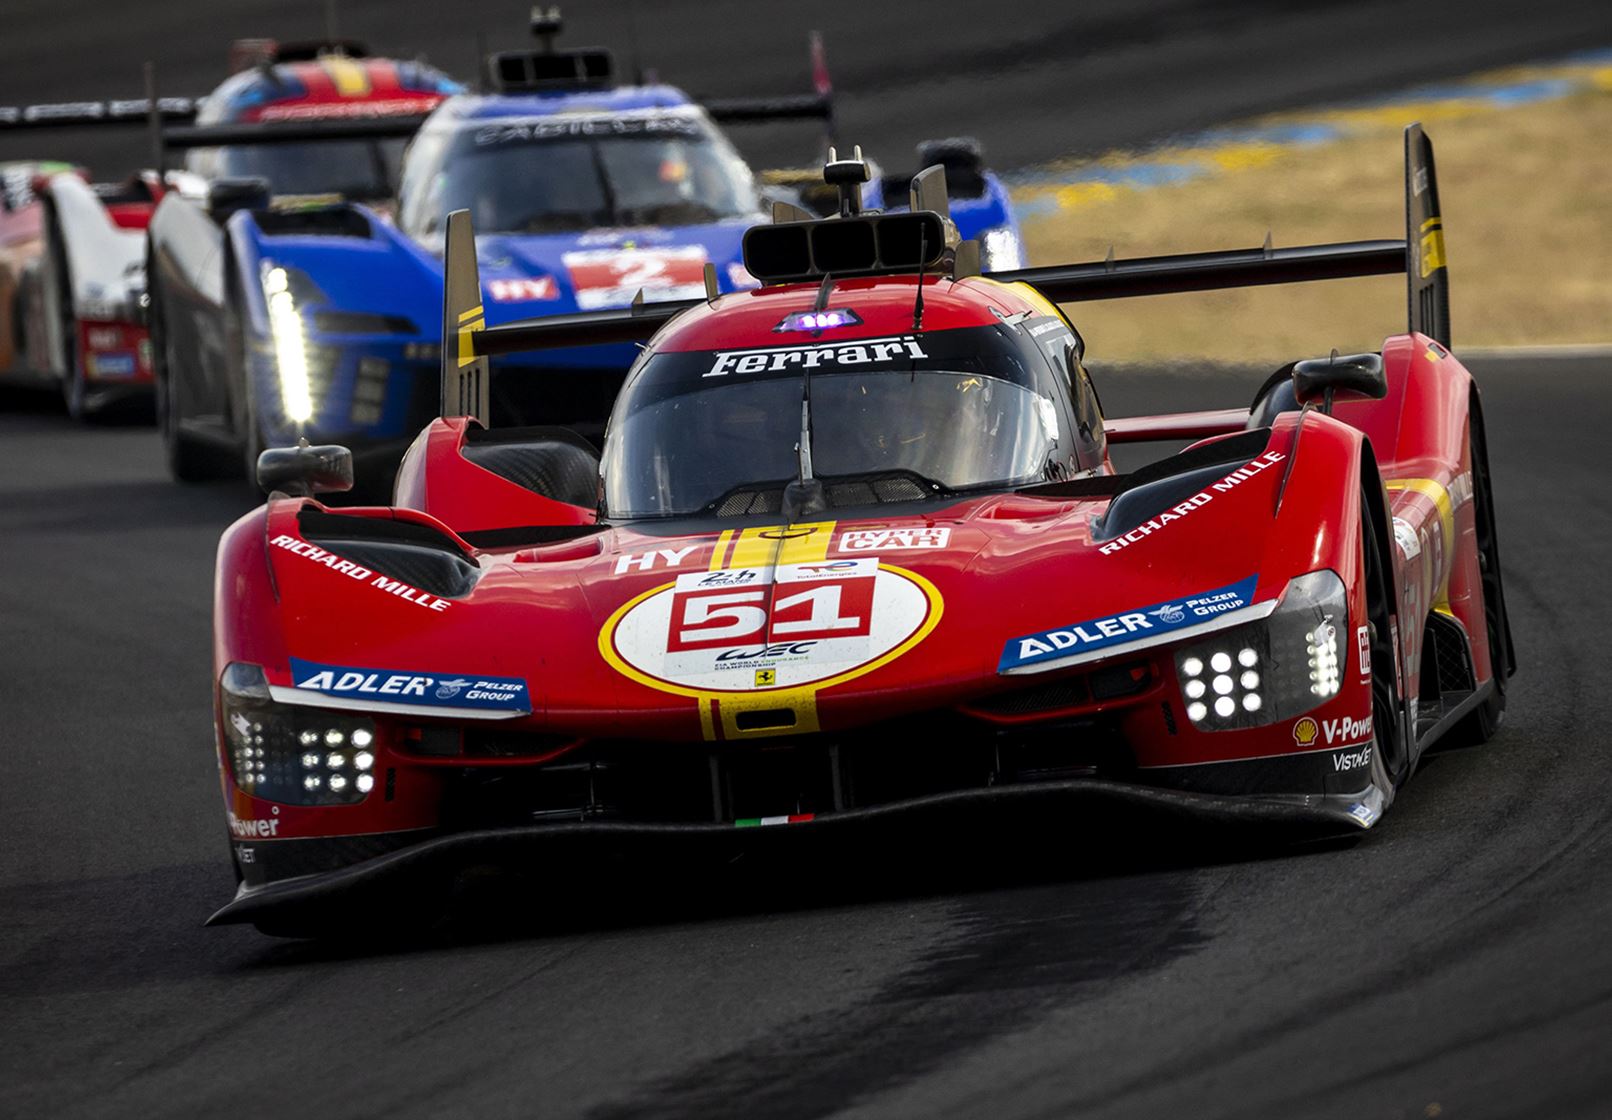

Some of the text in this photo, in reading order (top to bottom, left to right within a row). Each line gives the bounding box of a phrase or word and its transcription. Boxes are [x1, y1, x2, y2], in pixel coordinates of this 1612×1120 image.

[609, 255, 668, 289] 2
[702, 336, 929, 378] Ferrari
[1099, 450, 1286, 555] RICHARD MILLE
[846, 536, 939, 549] CAR
[614, 545, 699, 575] HY
[270, 534, 452, 612] RICHARD MILLE
[1186, 592, 1238, 608] PELZER
[1193, 599, 1244, 616] GROUP
[680, 585, 860, 643] 51
[1018, 612, 1153, 659] ADLER
[715, 641, 818, 661] WEC
[715, 662, 776, 671] CHAMPIONSHIP
[297, 671, 434, 696] ADLER
[465, 690, 515, 700] GROUP
[473, 681, 524, 691] PELZER
